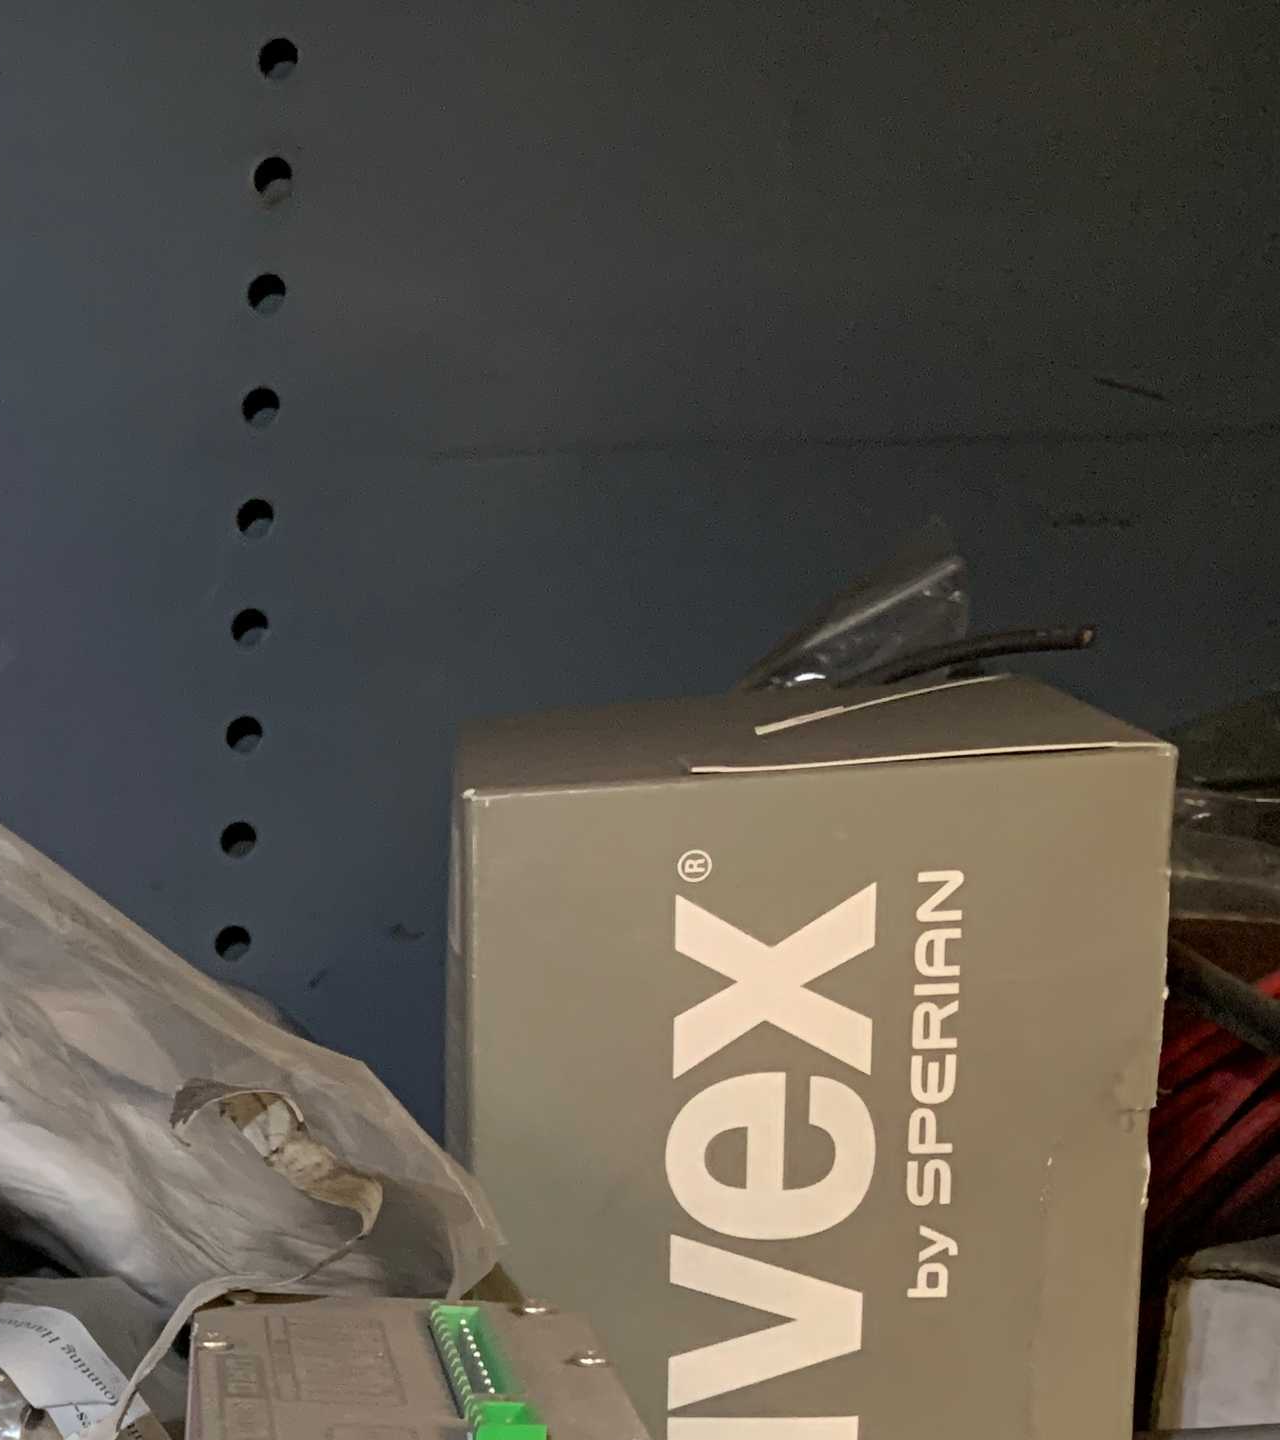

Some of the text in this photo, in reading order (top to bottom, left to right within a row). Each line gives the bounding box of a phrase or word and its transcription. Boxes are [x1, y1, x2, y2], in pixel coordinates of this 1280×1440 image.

[906, 869, 965, 1299] by SPERIAN
[60, 1343, 119, 1406] ounting
